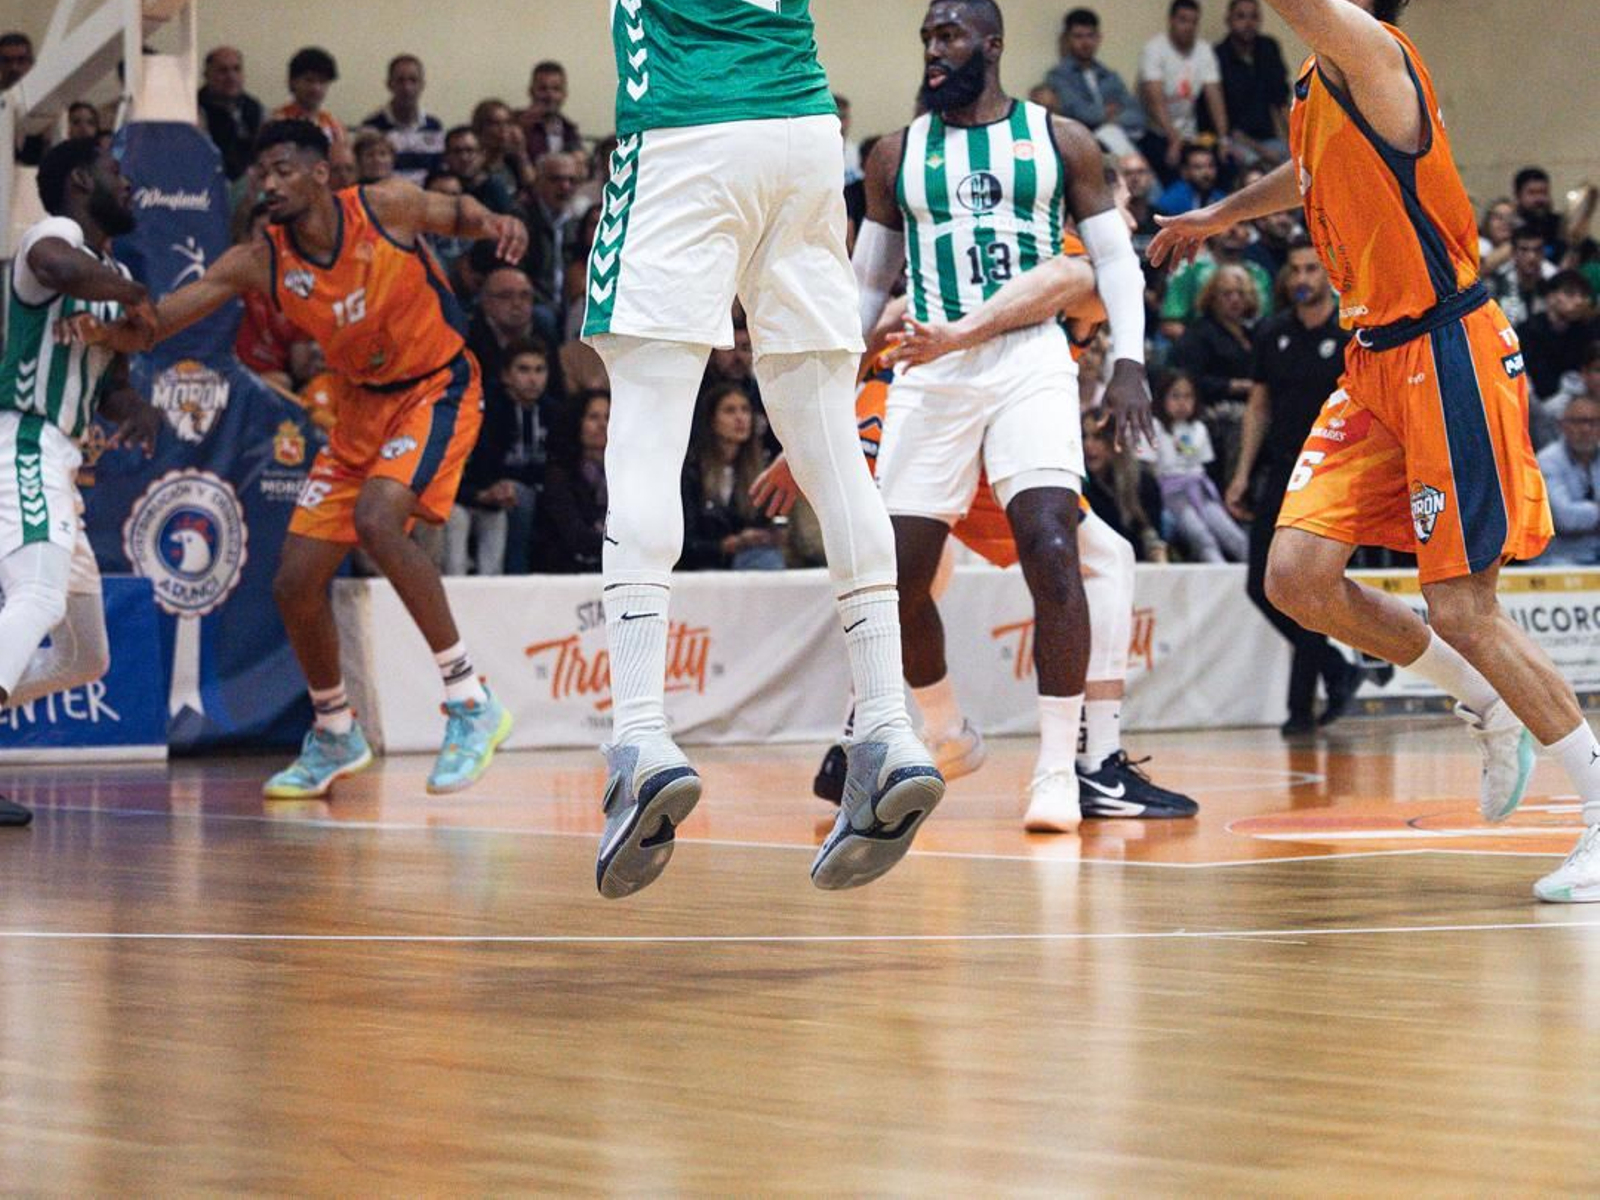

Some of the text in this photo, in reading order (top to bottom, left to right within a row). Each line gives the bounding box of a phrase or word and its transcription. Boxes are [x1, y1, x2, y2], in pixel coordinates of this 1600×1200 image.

[966, 242, 1013, 285] 13
[332, 287, 366, 328] 16
[1510, 605, 1600, 633] ICOR
